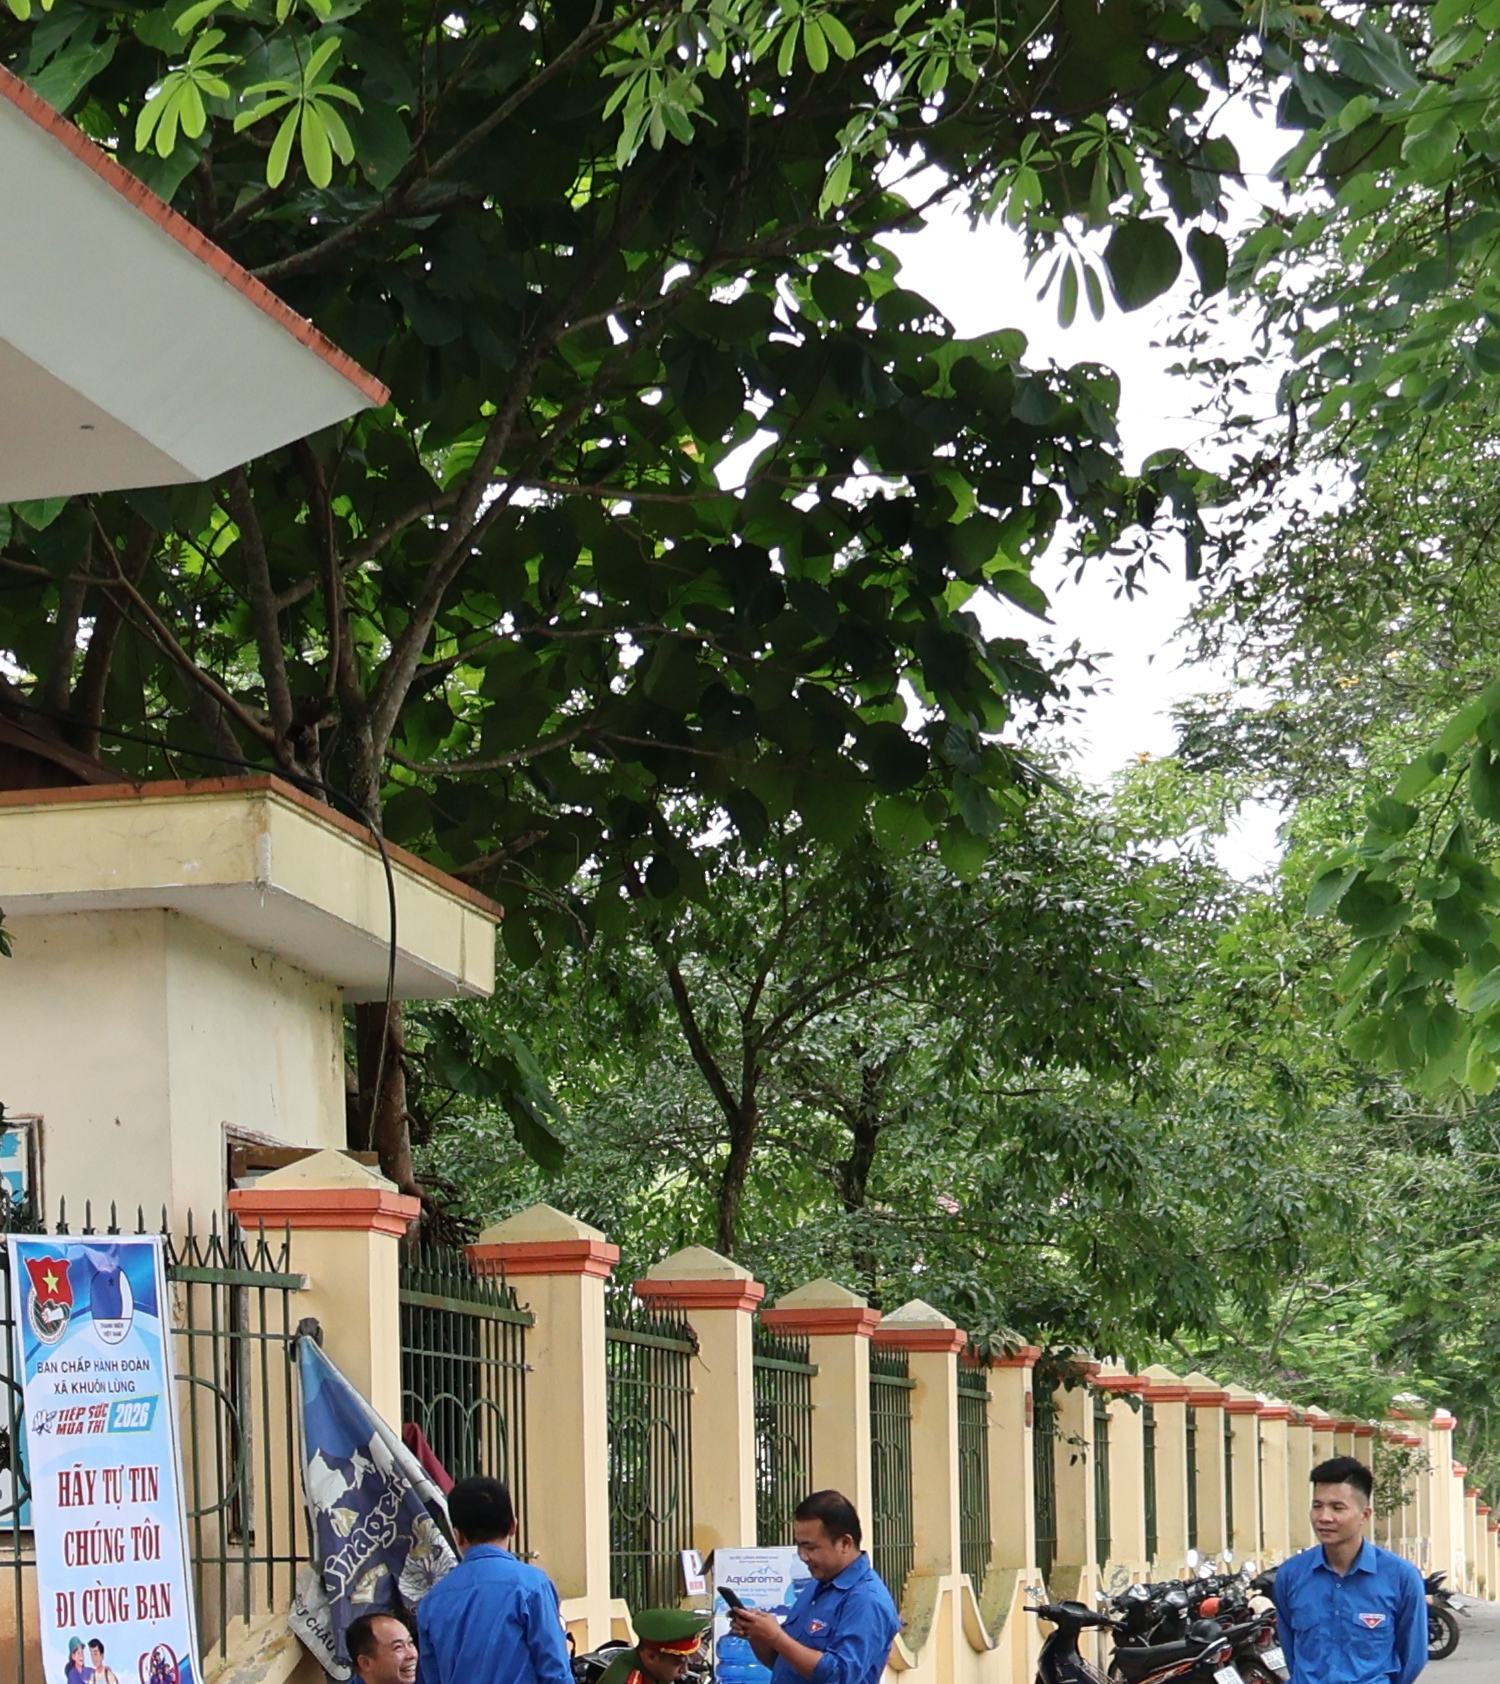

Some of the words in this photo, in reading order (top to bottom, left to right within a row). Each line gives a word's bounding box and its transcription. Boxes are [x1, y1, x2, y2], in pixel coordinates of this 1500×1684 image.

[37, 1361, 58, 1374] BAN
[61, 1356, 91, 1374] CHẤP
[93, 1358, 119, 1373] HÀNH
[121, 1355, 150, 1372] ĐOÀN
[54, 1380, 69, 1395] XÃ
[71, 1379, 106, 1395] KHUÔN
[109, 1378, 135, 1393] LÙNG
[113, 1401, 150, 1428] 2026
[87, 1419, 105, 1434] THI
[58, 1463, 97, 1507] HÃY
[103, 1465, 124, 1510] TỰ
[129, 1467, 158, 1503] TIN
[64, 1520, 125, 1567] CHÚNG
[131, 1517, 161, 1562] TÔI
[726, 1575, 784, 1586] Aquaroma
[56, 1591, 76, 1628] ĐI
[82, 1580, 130, 1626] CÙNG
[135, 1583, 171, 1626] BẠN
